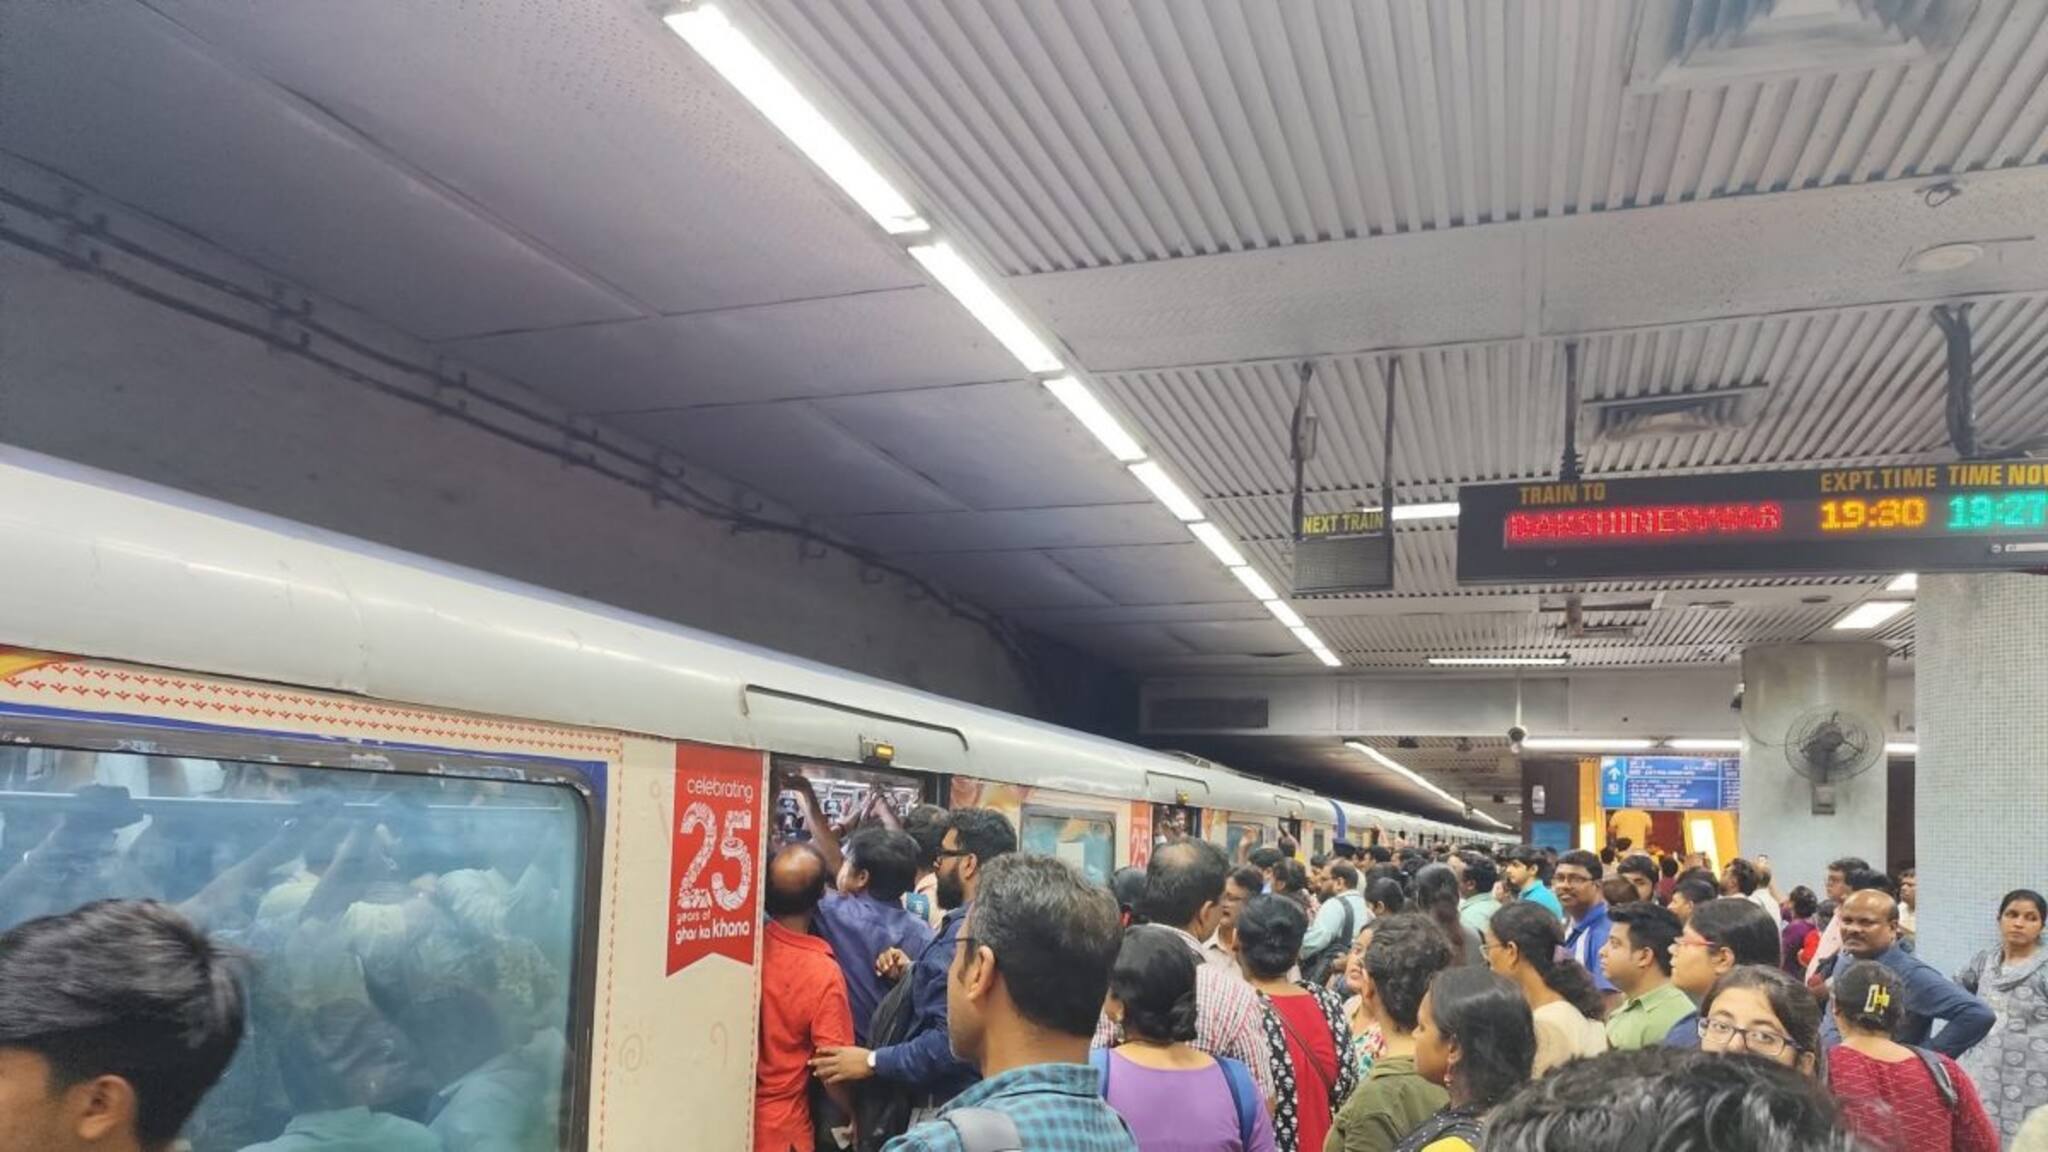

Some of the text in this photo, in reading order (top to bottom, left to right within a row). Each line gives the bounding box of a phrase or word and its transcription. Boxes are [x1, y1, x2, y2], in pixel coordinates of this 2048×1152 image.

[1881, 467, 1937, 488] TIME
[1949, 465, 2002, 485] TIME
[1519, 483, 1605, 504] TRAIN TO
[1820, 499, 1927, 529] 19:30
[1949, 492, 2047, 528] 19:27
[1303, 512, 1383, 533] NEXT TRAIN
[687, 779, 754, 803] celebrating
[677, 801, 752, 911] 25
[676, 909, 711, 925] years of
[675, 917, 750, 945] ghar ka khana
